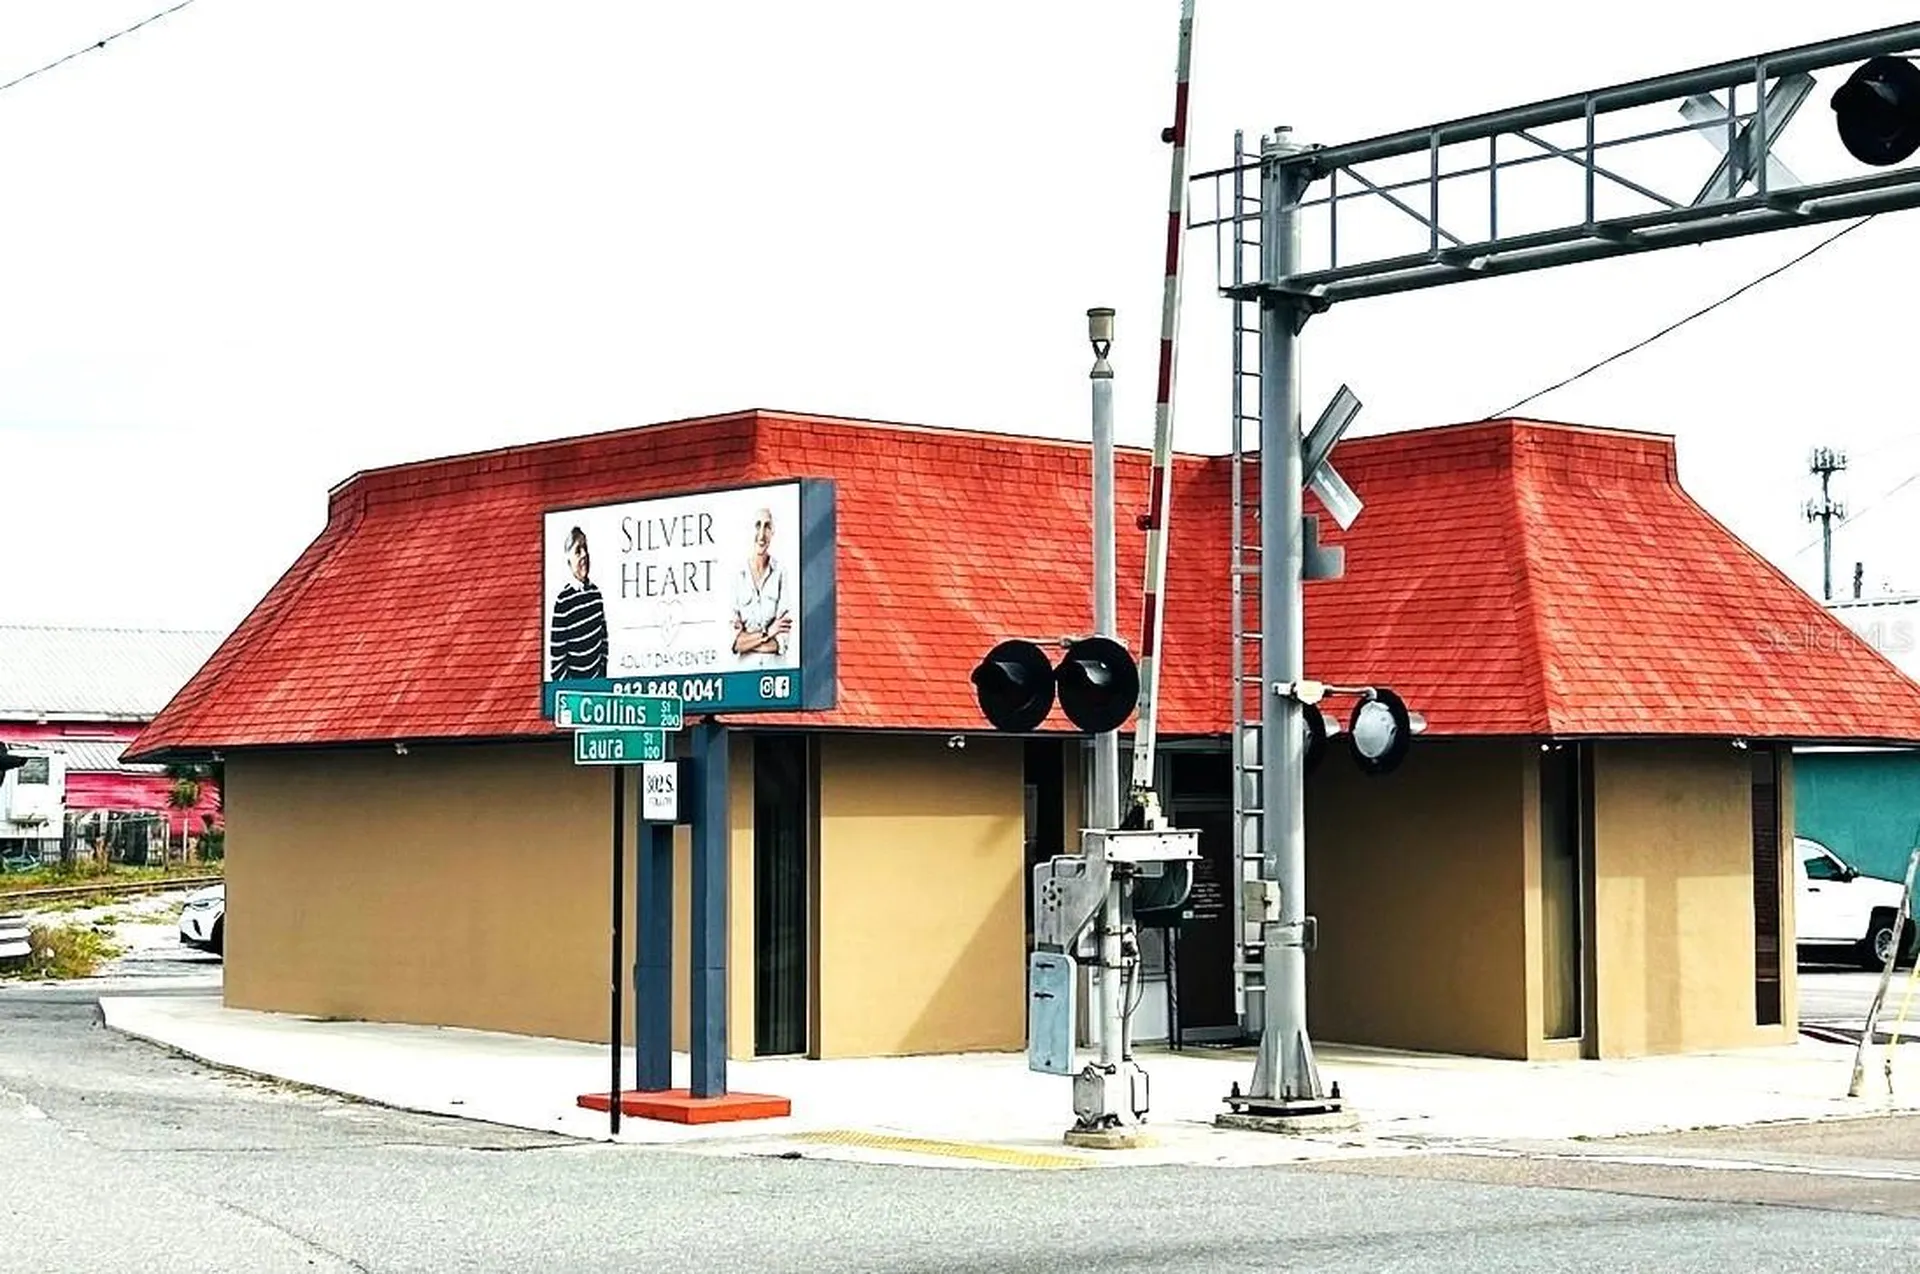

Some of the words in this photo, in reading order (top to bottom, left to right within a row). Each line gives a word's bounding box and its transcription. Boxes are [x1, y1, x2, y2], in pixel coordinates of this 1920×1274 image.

[621, 512, 715, 554] SILVER
[621, 559, 717, 599] HEART
[677, 649, 717, 667] CENTER
[682, 677, 724, 702] 0041
[579, 696, 647, 725] Collins
[660, 713, 680, 727] 200
[579, 733, 624, 760] Laura
[643, 746, 660, 760] 100
